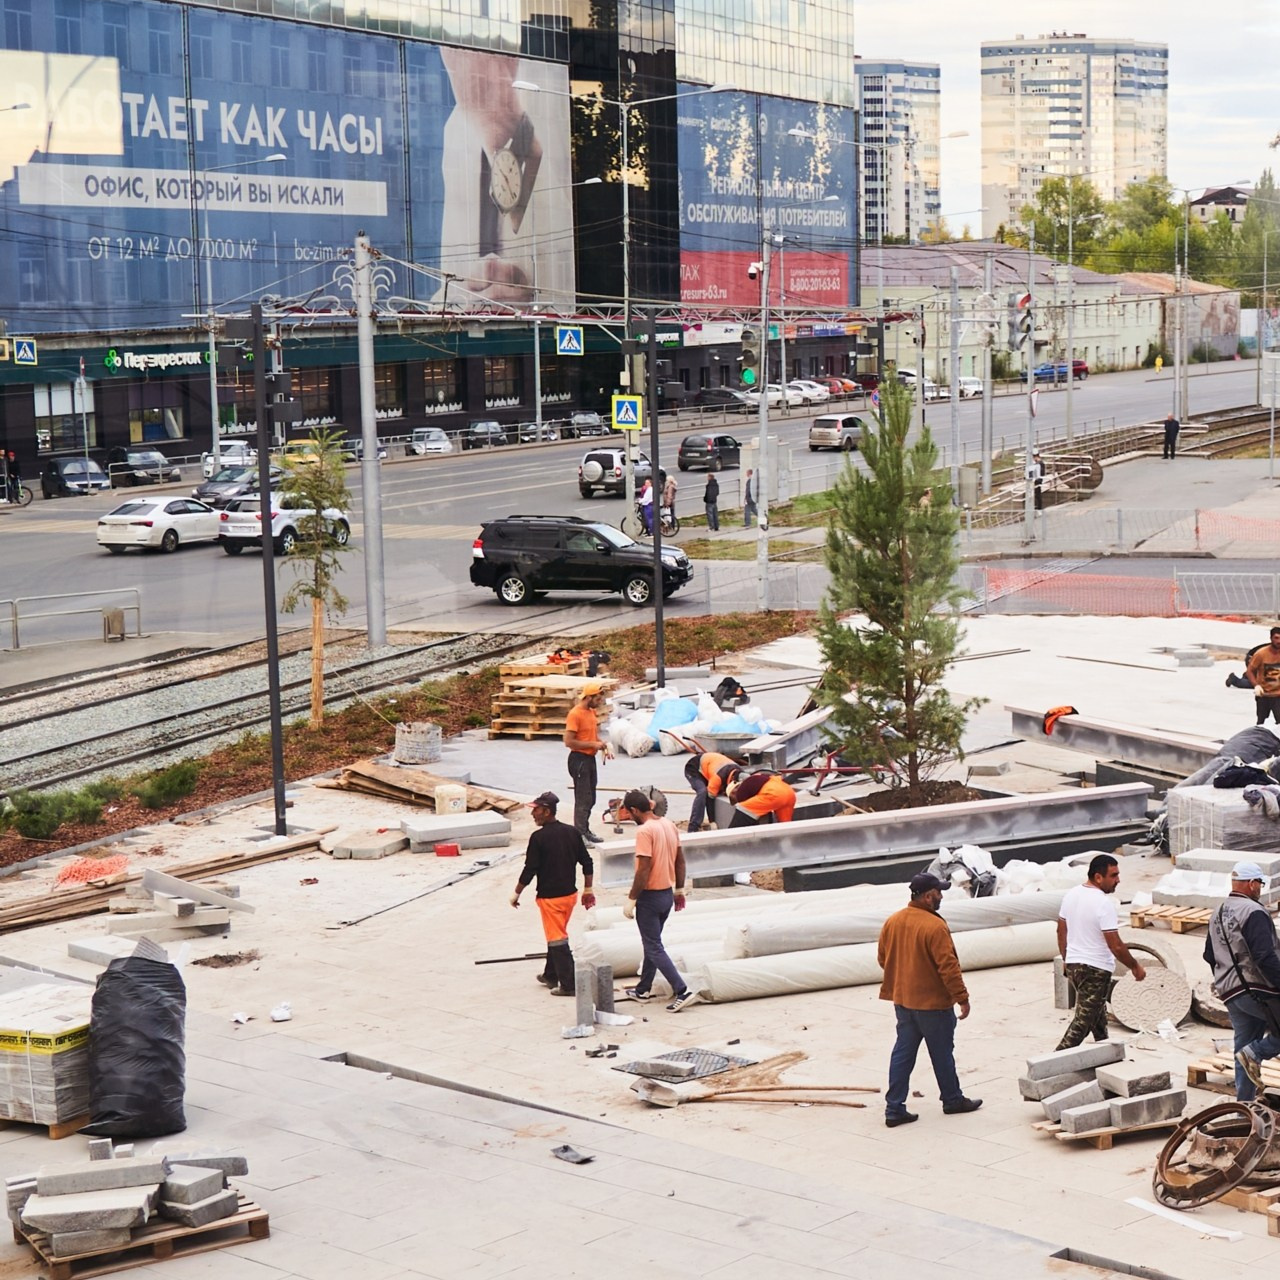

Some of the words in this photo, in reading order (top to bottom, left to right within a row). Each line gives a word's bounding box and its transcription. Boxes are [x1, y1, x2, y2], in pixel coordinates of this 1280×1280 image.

[219, 101, 289, 148] КАК
[297, 109, 384, 156] ЧАСЫ
[84, 174, 149, 203] ОФИС,
[156, 176, 242, 203] КОТОРЫЙ
[249, 183, 272, 204] ВЫ
[278, 184, 344, 207] ИСКАЛИ
[687, 203, 776, 226] ОБСЛУЖИВАНИЯ
[779, 205, 847, 228] ПОТРЕБИТЕЛЕЙ
[88, 237, 111, 260] ОТ
[116, 237, 134, 260] 12
[165, 237, 192, 262] ДО
[680, 264, 701, 281] ТАЖ
